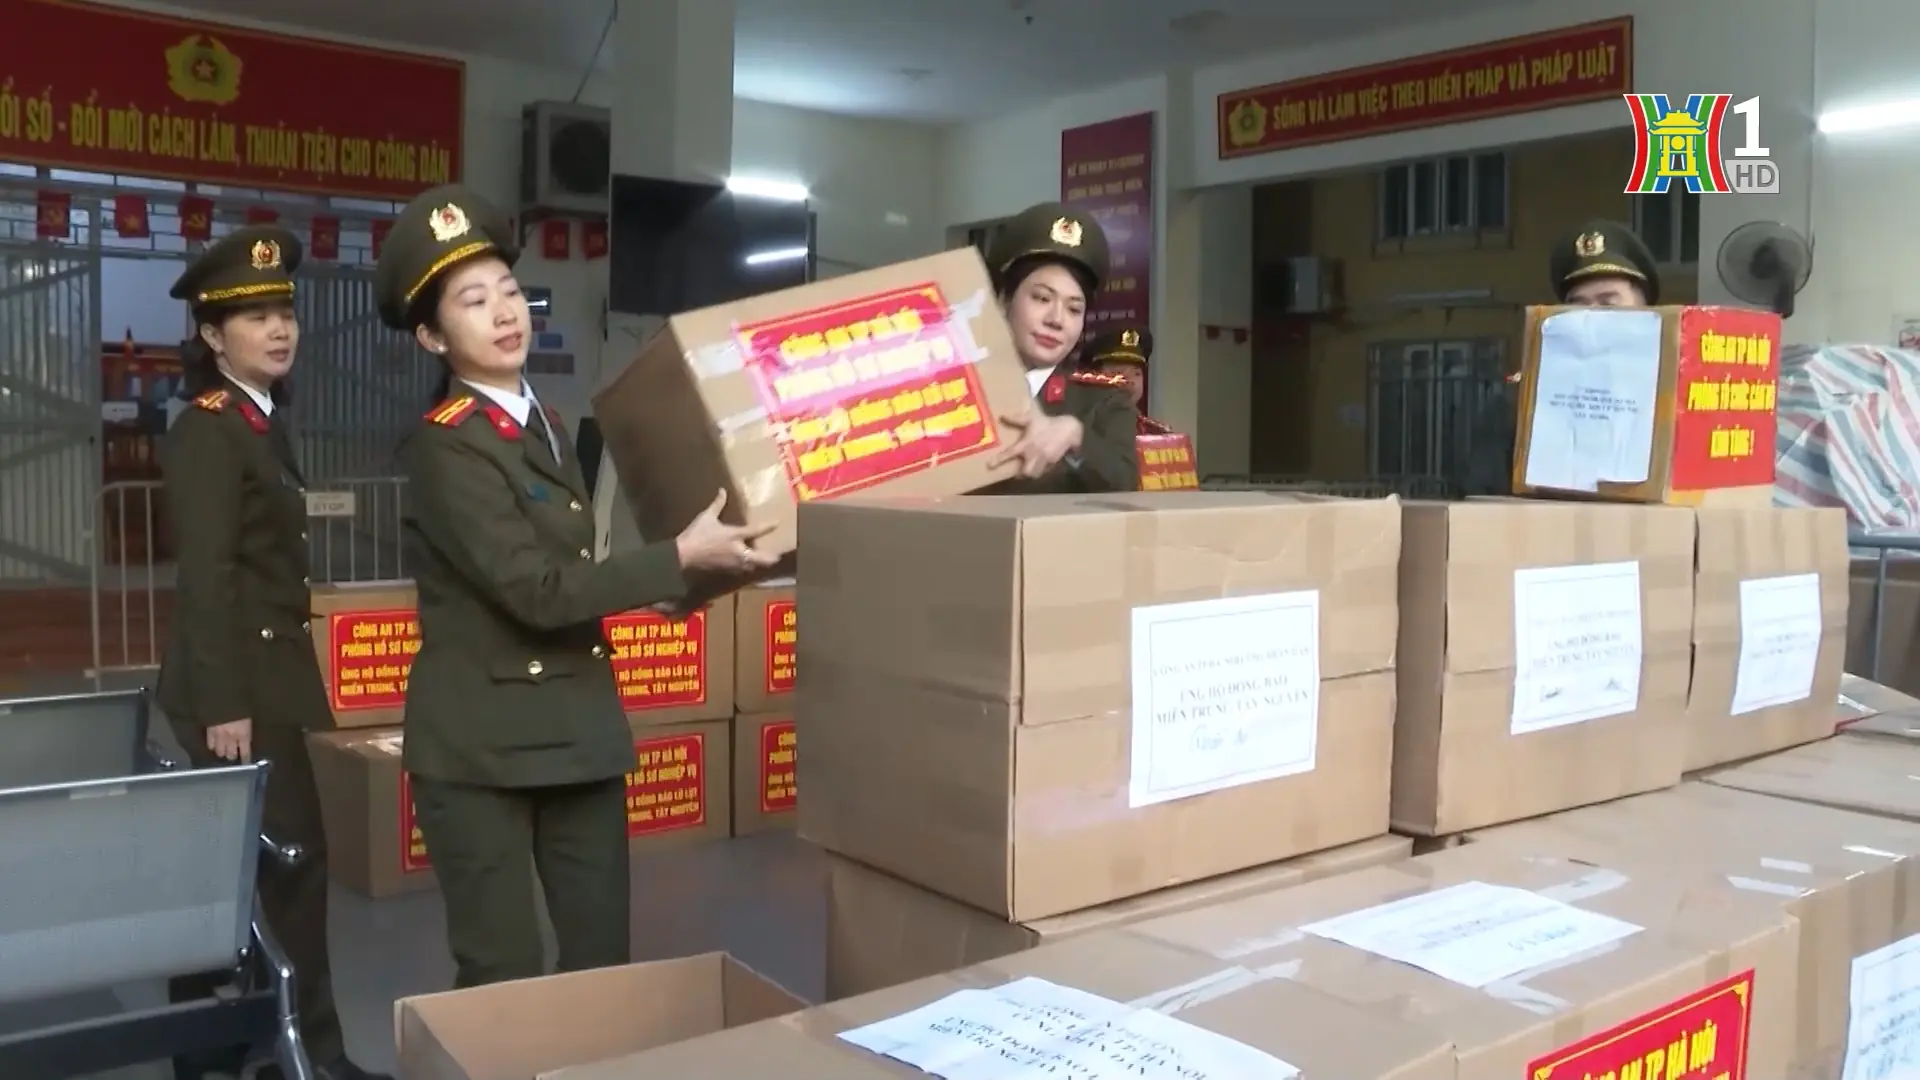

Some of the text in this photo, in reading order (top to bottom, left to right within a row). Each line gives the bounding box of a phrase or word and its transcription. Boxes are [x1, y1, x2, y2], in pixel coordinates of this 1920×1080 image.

[1391, 79, 1425, 109] THEO
[1508, 55, 1528, 91] VÀ
[1532, 49, 1573, 88] PHÁP
[1577, 41, 1616, 84] LUẬT
[26, 84, 52, 142] SỐ
[341, 137, 371, 177] CHO
[353, 622, 378, 639] CÔNG
[379, 623, 393, 637] AN
[394, 622, 406, 636] TP
[611, 623, 634, 641] CÔNG
[635, 625, 648, 639] AN
[648, 624, 660, 638] TP
[1666, 1030, 1688, 1080] HÀ
[1688, 1019, 1718, 1075] NỘI
